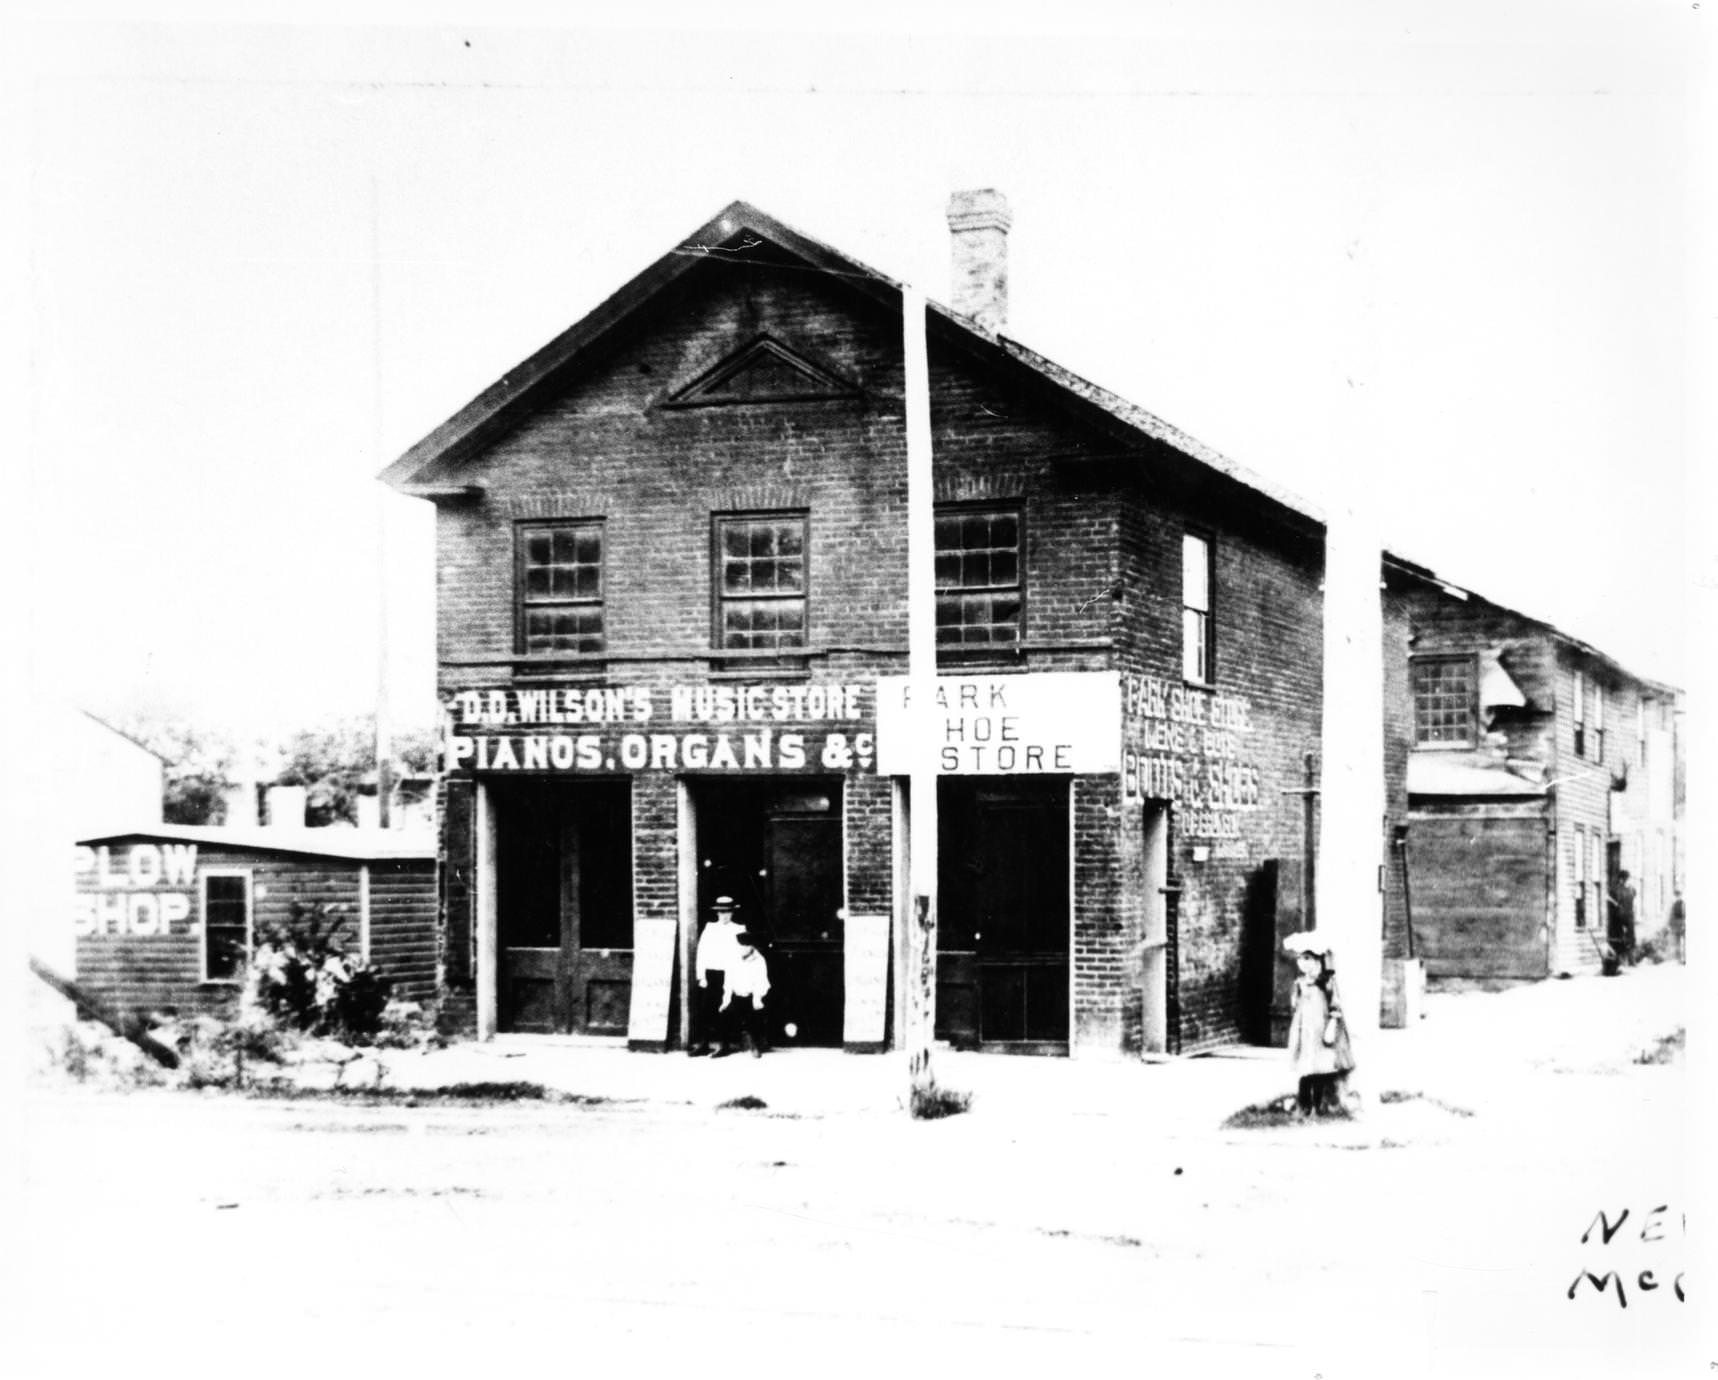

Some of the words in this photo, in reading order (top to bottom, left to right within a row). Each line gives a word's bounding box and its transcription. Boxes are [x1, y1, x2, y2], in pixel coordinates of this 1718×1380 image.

[516, 687, 652, 723] WILSON'S
[672, 685, 765, 721] MUSIC
[772, 684, 862, 720] STORE
[946, 716, 1020, 742] HOE
[621, 731, 806, 769] ORGANS
[941, 744, 1073, 771] STORE
[1580, 1204, 1686, 1246] NE
